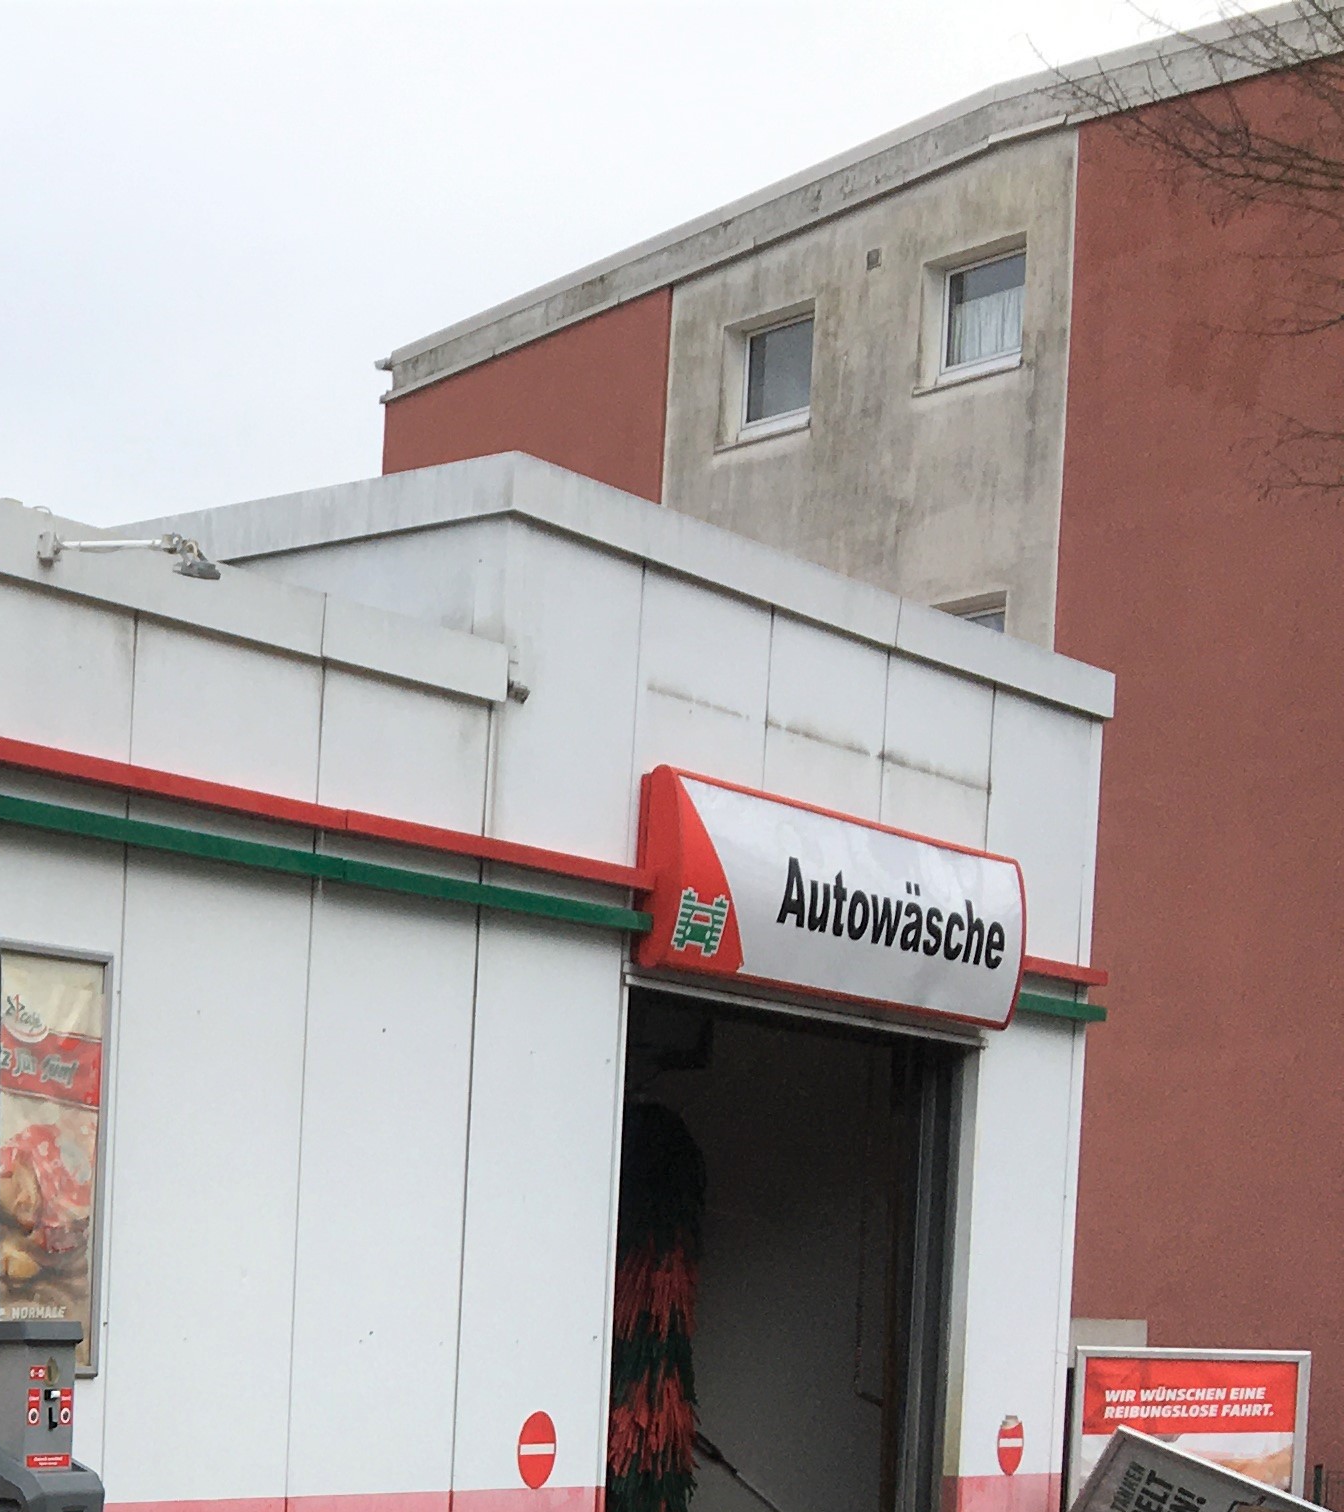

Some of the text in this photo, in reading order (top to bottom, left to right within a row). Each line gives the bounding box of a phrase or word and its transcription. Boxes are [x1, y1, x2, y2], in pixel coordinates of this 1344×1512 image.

[776, 856, 1005, 969] Autowäsche
[12, 1306, 67, 1319] NORMALE
[1104, 1386, 1266, 1402] WIR WÜNSCHEN EINE
[1103, 1403, 1274, 1419] REIBUNGSLOSE FAHRT.
